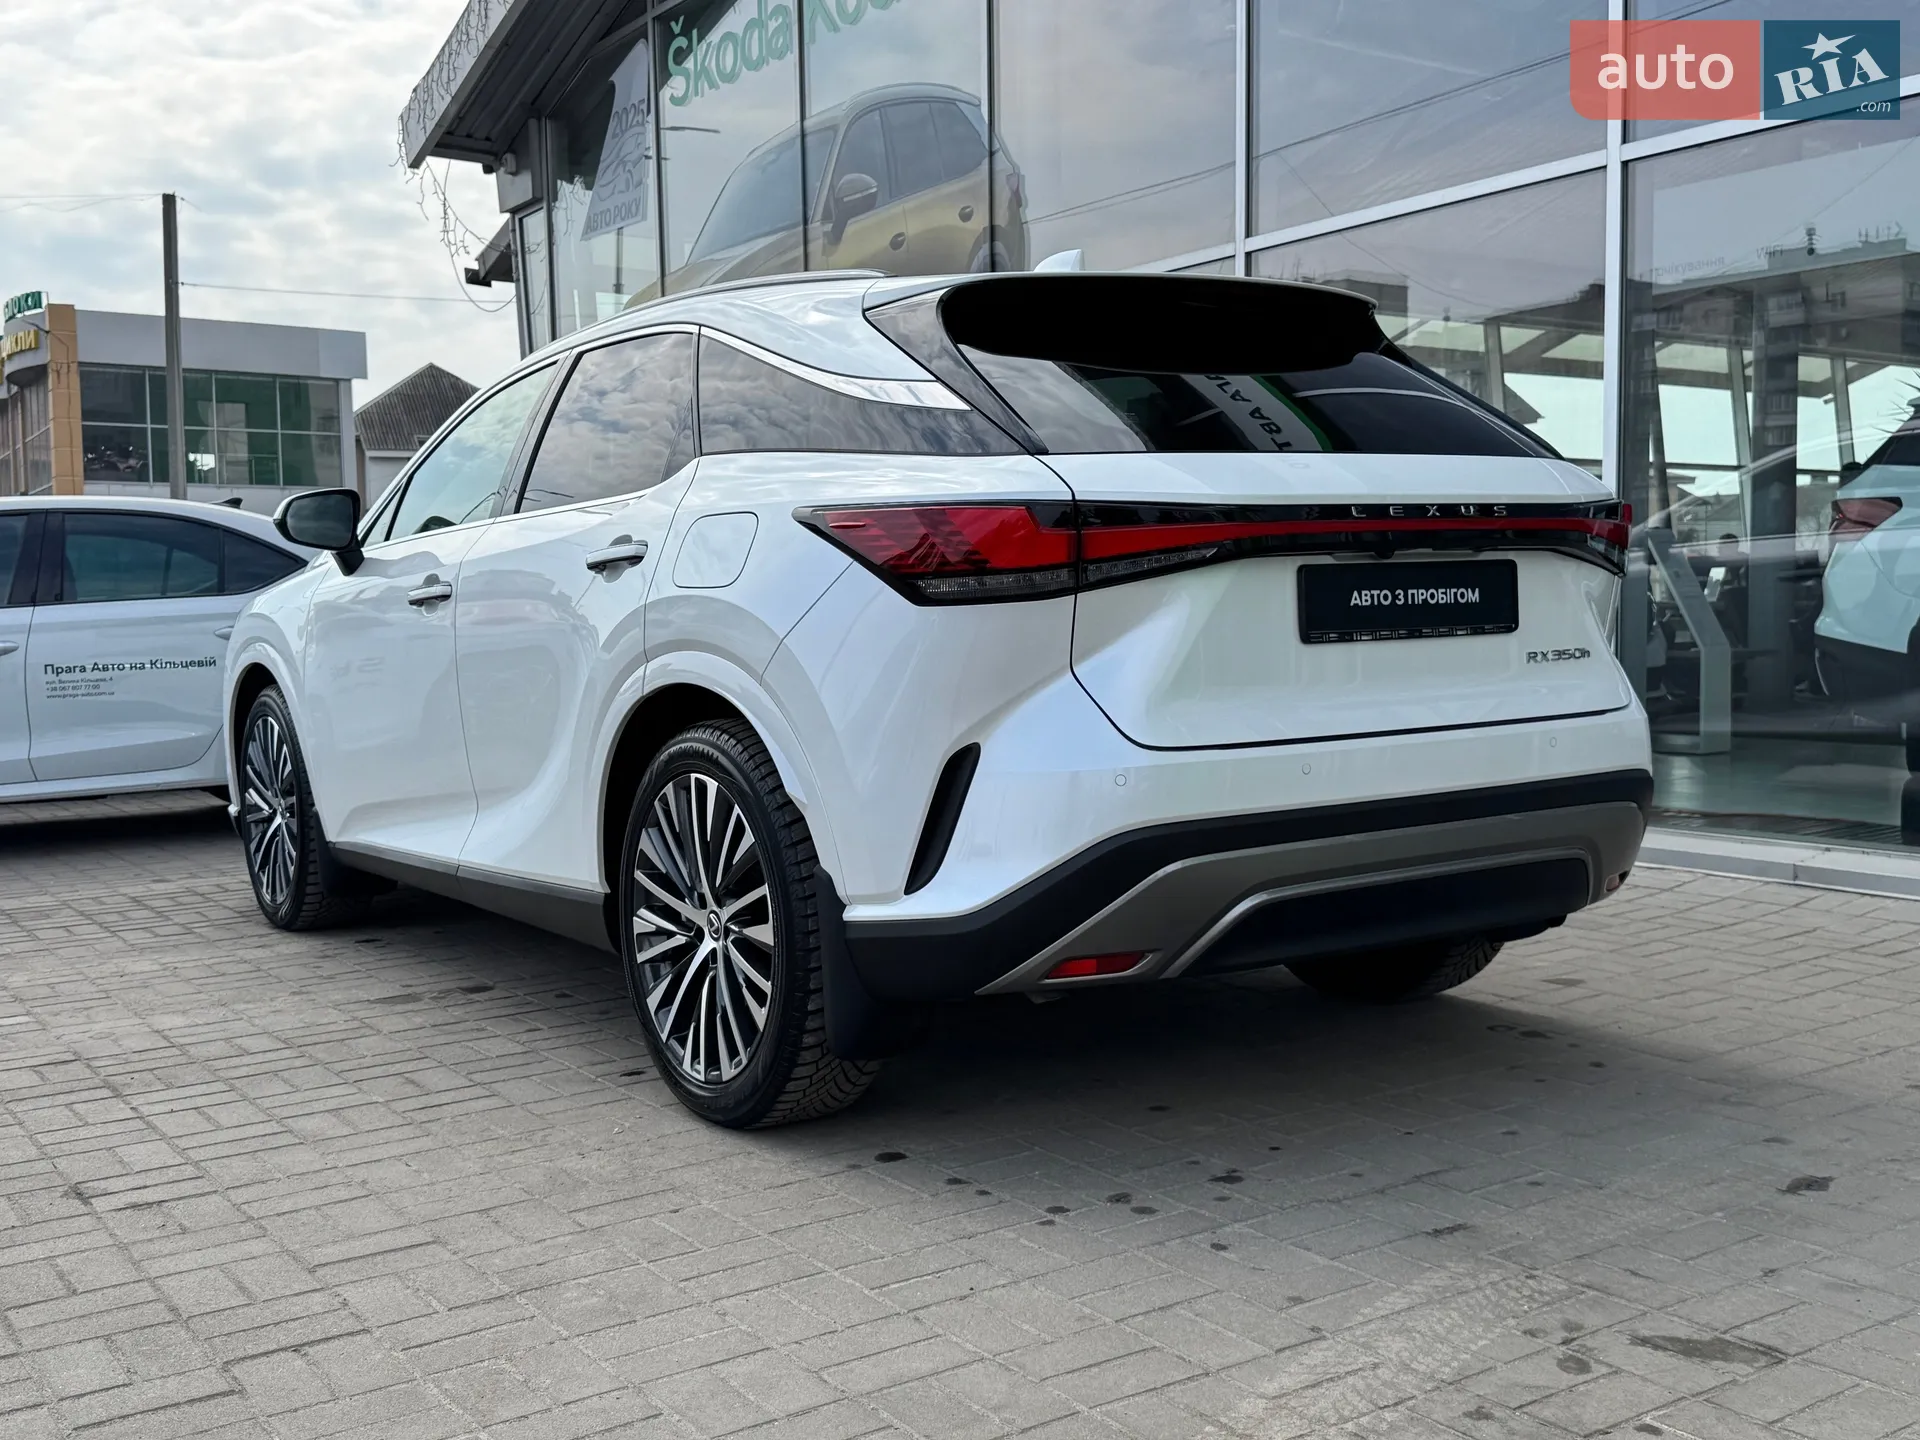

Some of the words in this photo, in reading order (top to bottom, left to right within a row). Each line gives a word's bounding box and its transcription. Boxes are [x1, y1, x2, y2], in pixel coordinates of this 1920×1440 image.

[667, 0, 792, 107] Škoda
[611, 98, 646, 140] 2025
[584, 207, 613, 235] АВТО
[613, 196, 642, 225] РОКУ
[1351, 505, 1508, 518] LEXUS
[1350, 589, 1392, 606] АВТО
[1407, 588, 1480, 605] ПРОБІГОМ
[44, 663, 87, 677] Прага
[91, 661, 126, 673] Авто
[129, 661, 146, 671] на
[149, 656, 217, 670] Кільцевій
